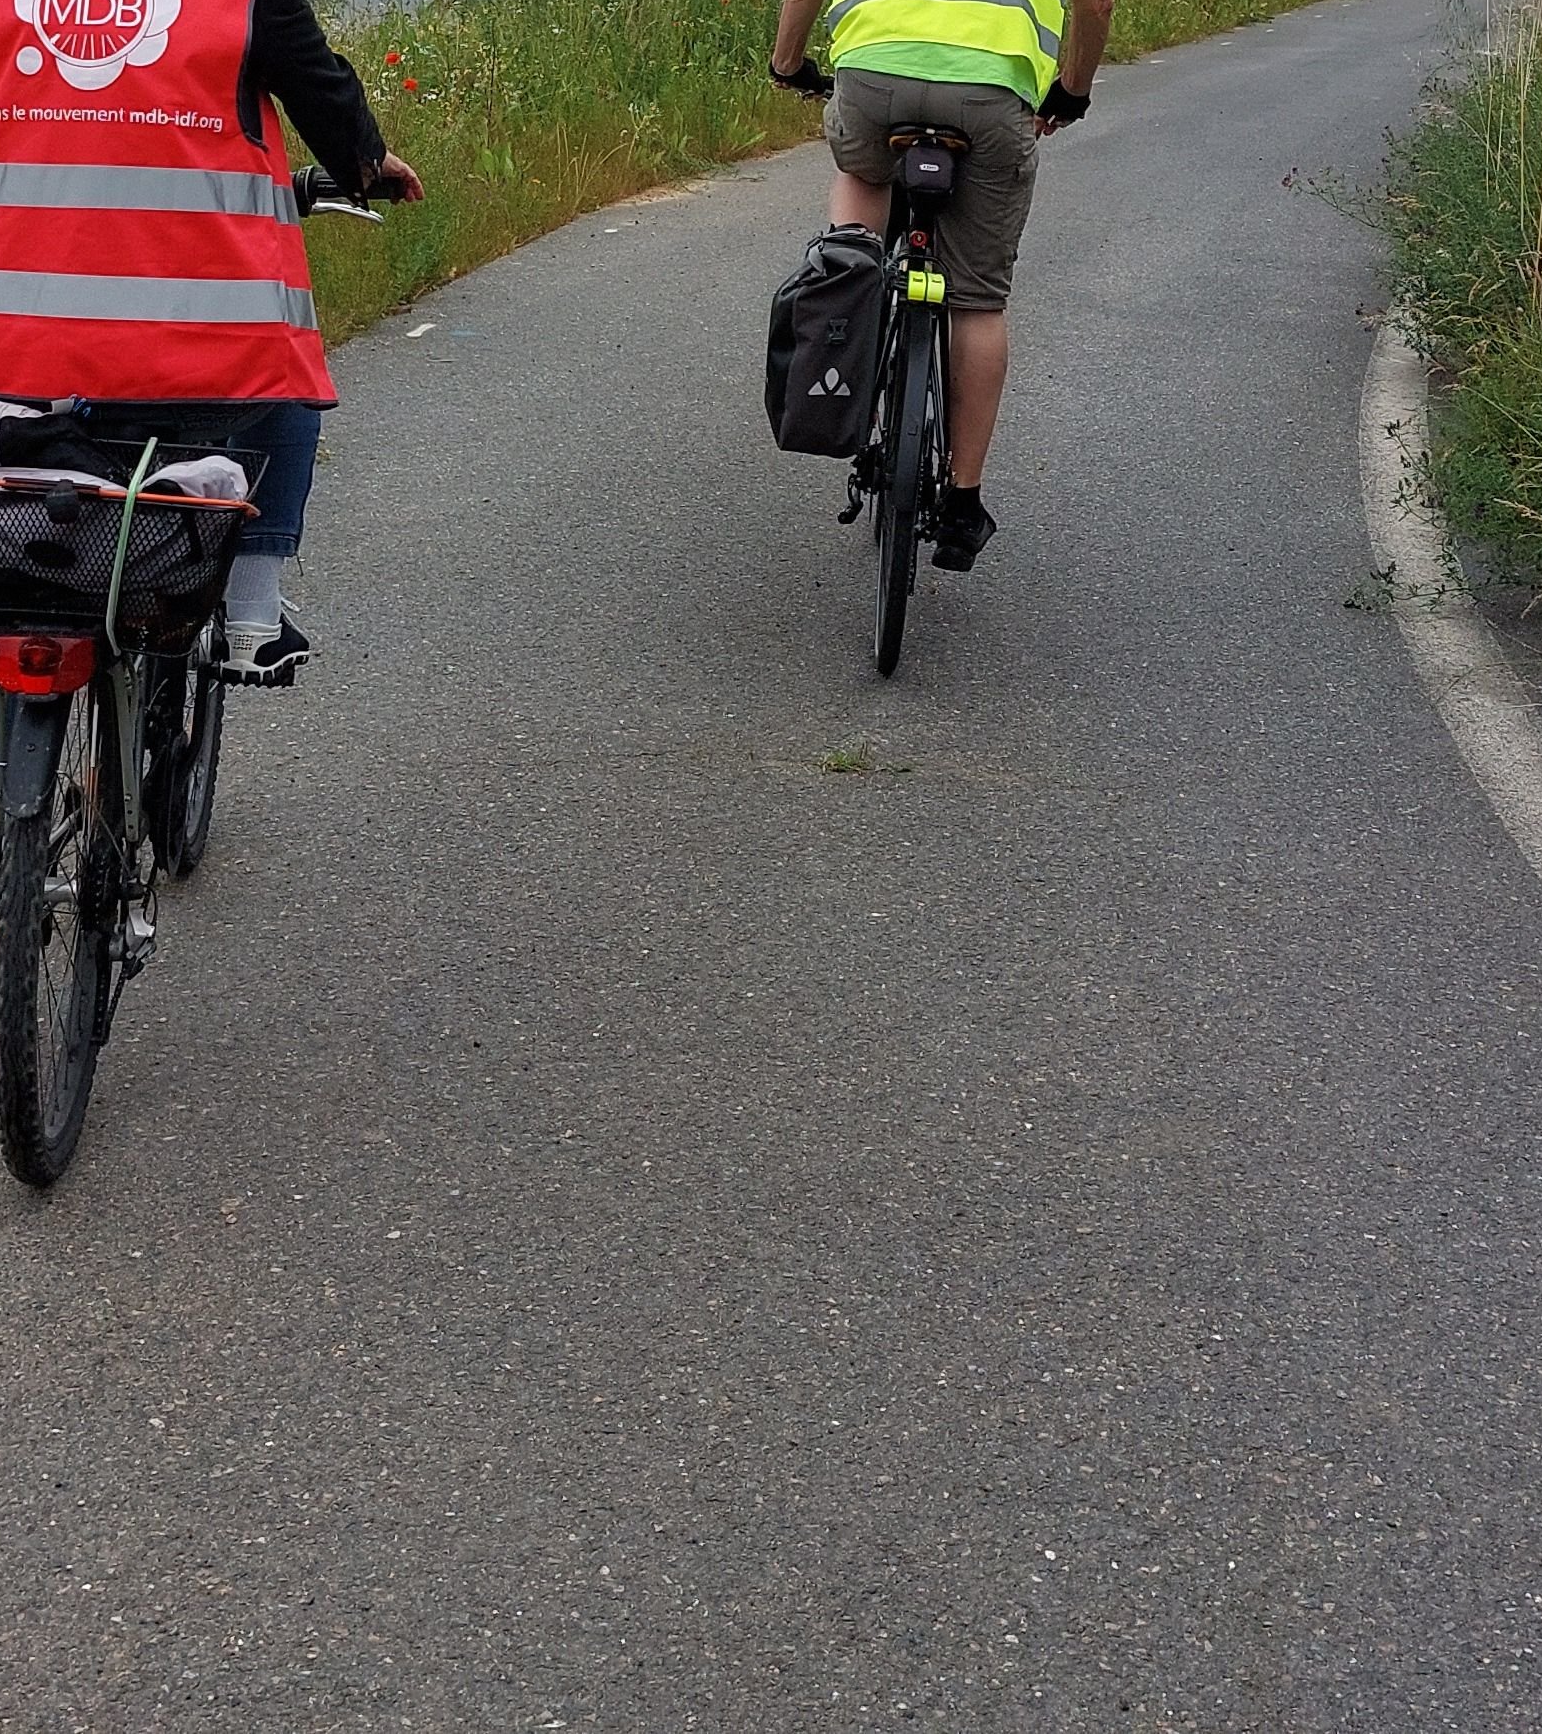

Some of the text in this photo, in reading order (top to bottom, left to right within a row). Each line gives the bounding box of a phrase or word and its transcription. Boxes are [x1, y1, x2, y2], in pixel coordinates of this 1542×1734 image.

[12, 104, 26, 122] le
[29, 107, 126, 124] mouvement
[129, 108, 223, 133] mdb-idf.org
